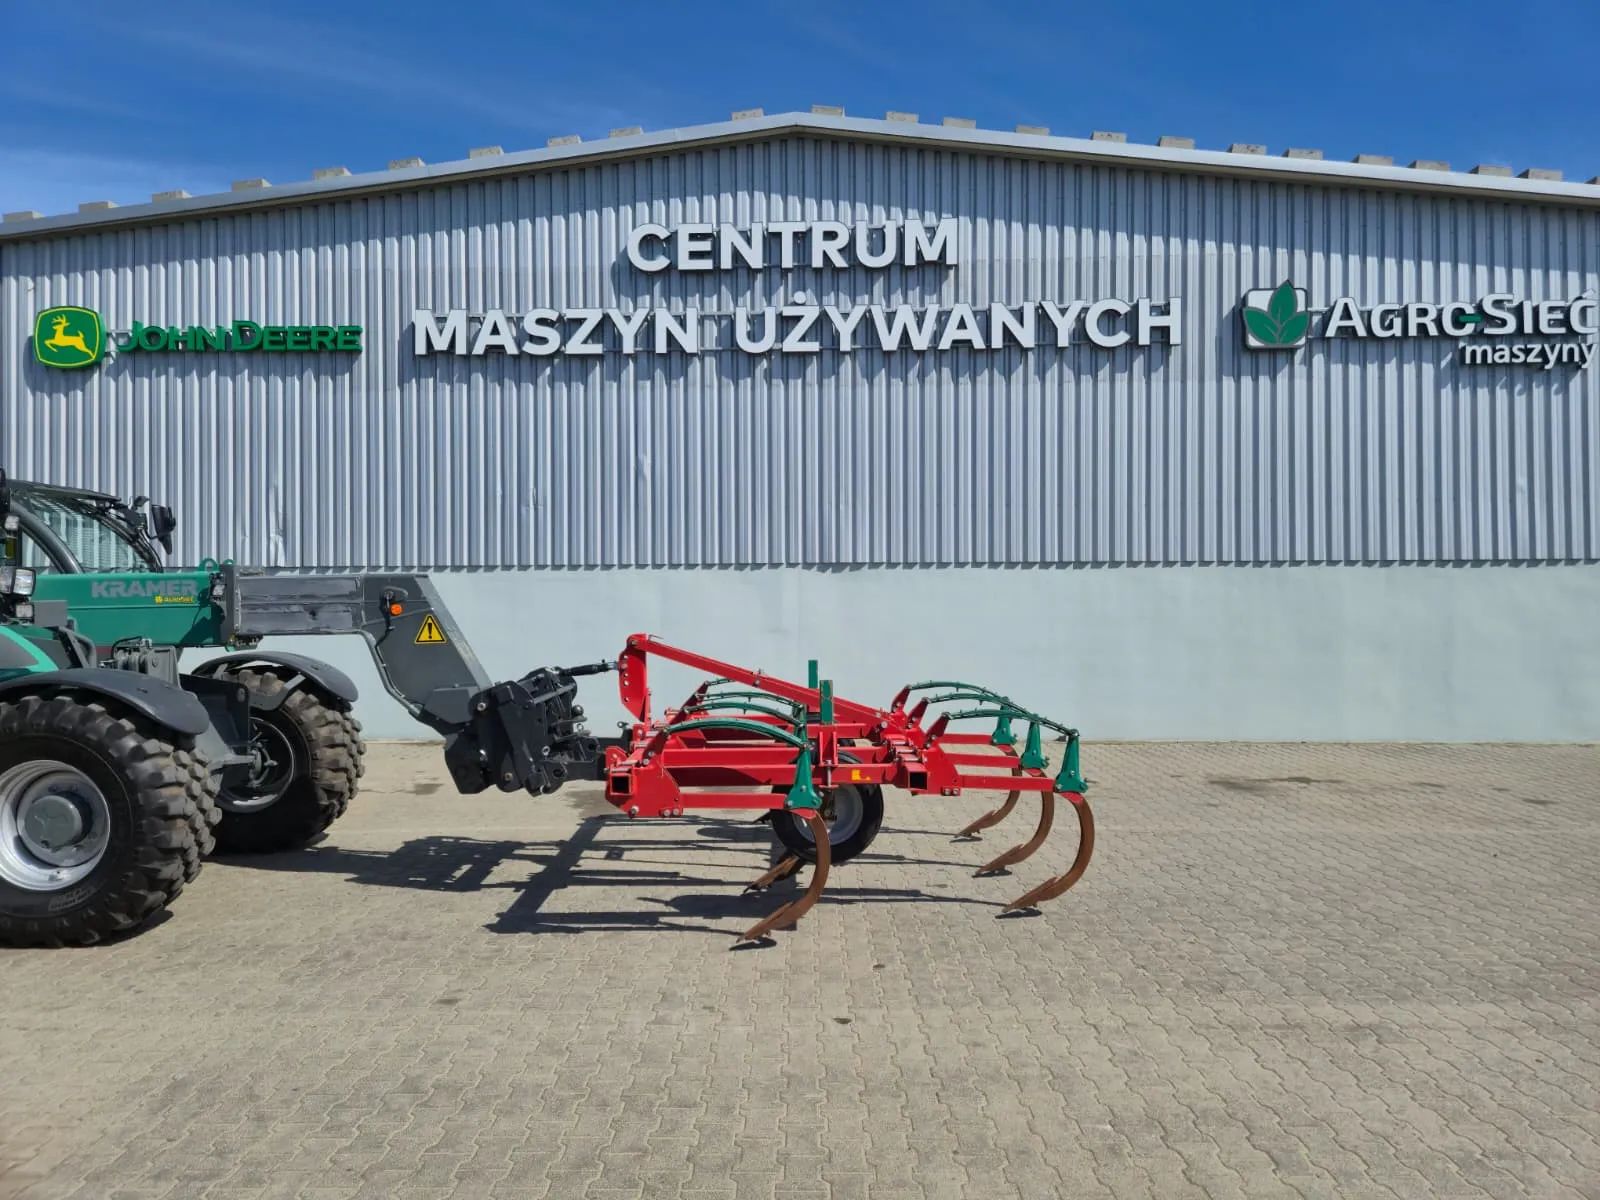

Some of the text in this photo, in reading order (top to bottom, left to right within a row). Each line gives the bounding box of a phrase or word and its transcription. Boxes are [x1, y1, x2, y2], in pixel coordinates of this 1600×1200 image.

[626, 219, 958, 272] CENTRUM
[116, 320, 362, 352] JOHN DEERE
[413, 291, 1183, 356] MASZYN UŻYWANYCH
[1464, 342, 1598, 369] maszyny
[91, 580, 199, 598] KRAMER
